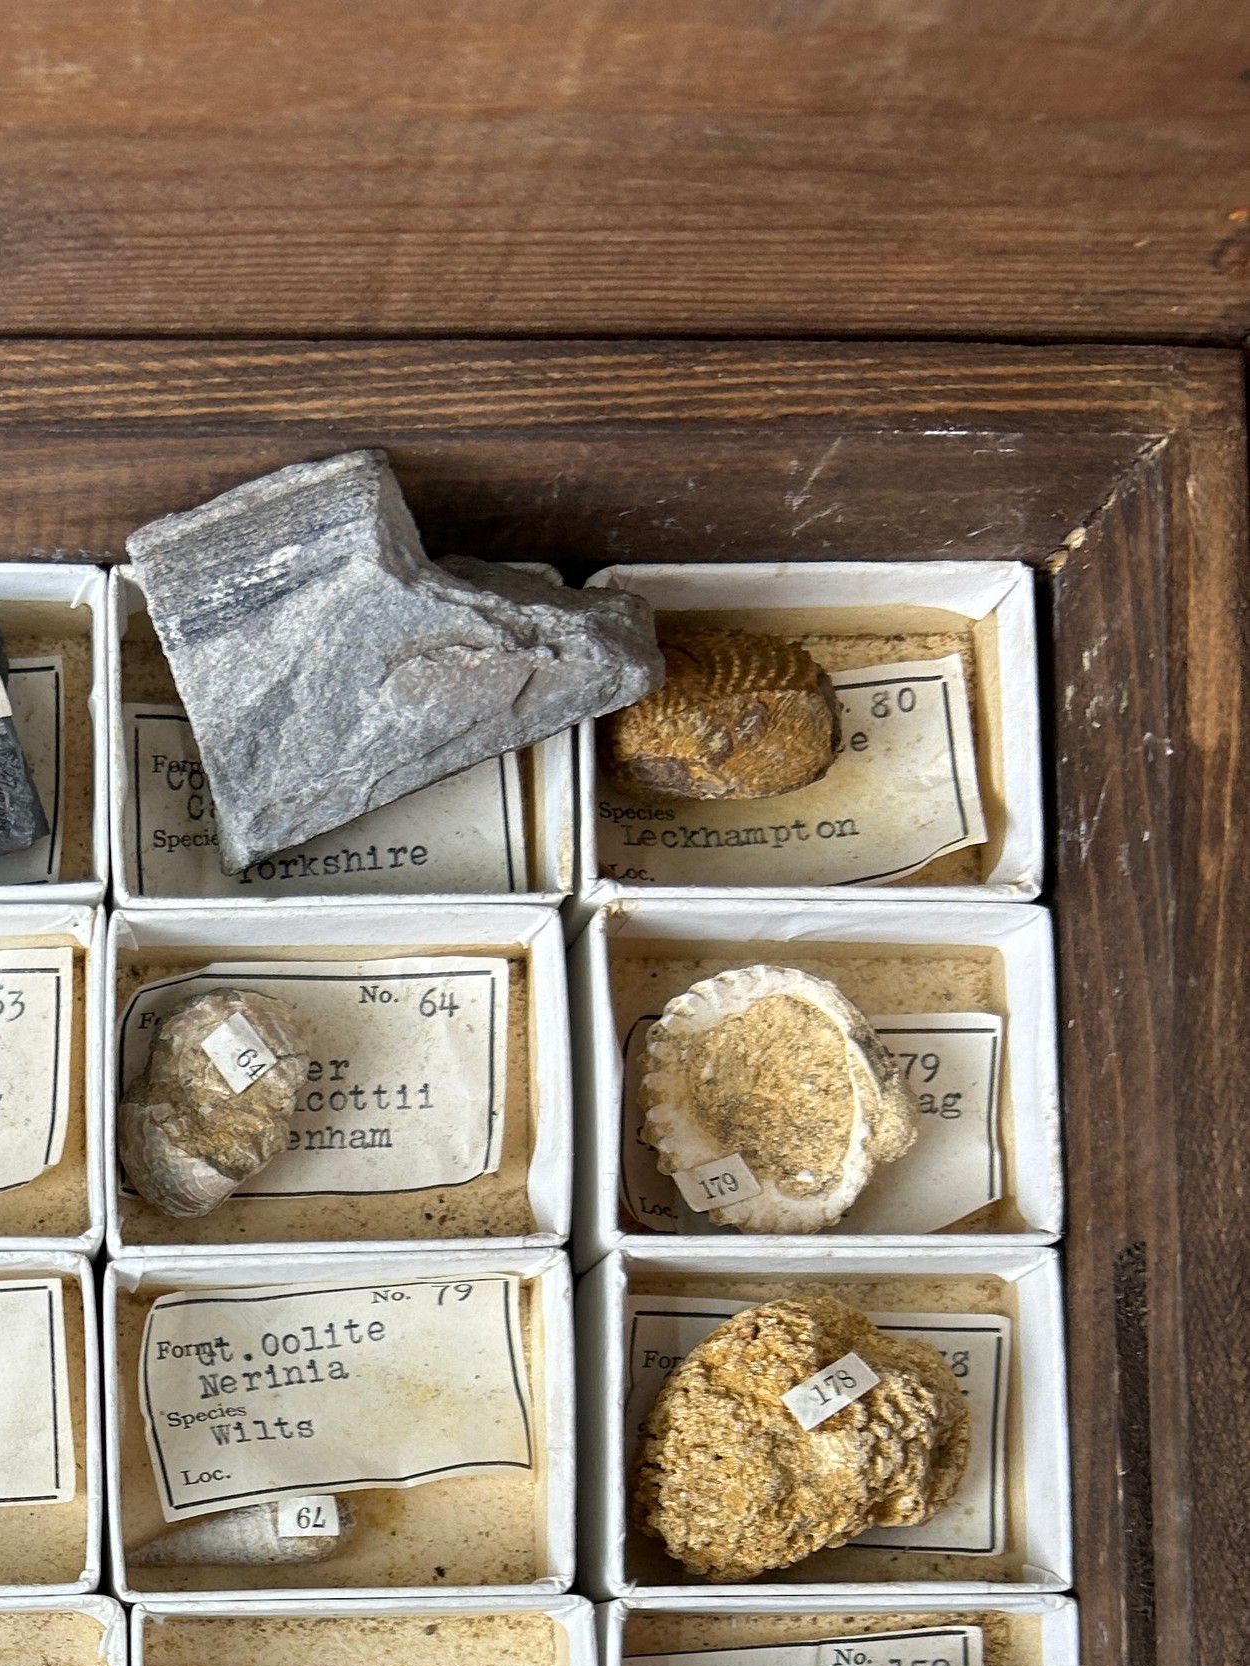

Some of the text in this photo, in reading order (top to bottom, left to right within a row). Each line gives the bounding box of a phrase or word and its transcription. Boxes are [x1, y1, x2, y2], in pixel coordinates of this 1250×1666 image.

[870, 687, 916, 718] 80
[599, 802, 675, 822] Species
[152, 831, 219, 848] Specie
[621, 816, 860, 849] Leckhampton
[359, 985, 460, 1018] No. 64
[698, 1172, 739, 1199] 179
[639, 1197, 679, 1220] Loc.
[371, 1283, 474, 1307] No. 79
[199, 1360, 350, 1399] Nerinia
[808, 1368, 858, 1407] 178
[167, 1404, 248, 1428] Species
[210, 1418, 316, 1446] Wilts
[181, 1469, 232, 1486] Loc.
[296, 1506, 327, 1531] 79
[833, 1648, 873, 1666] No.
